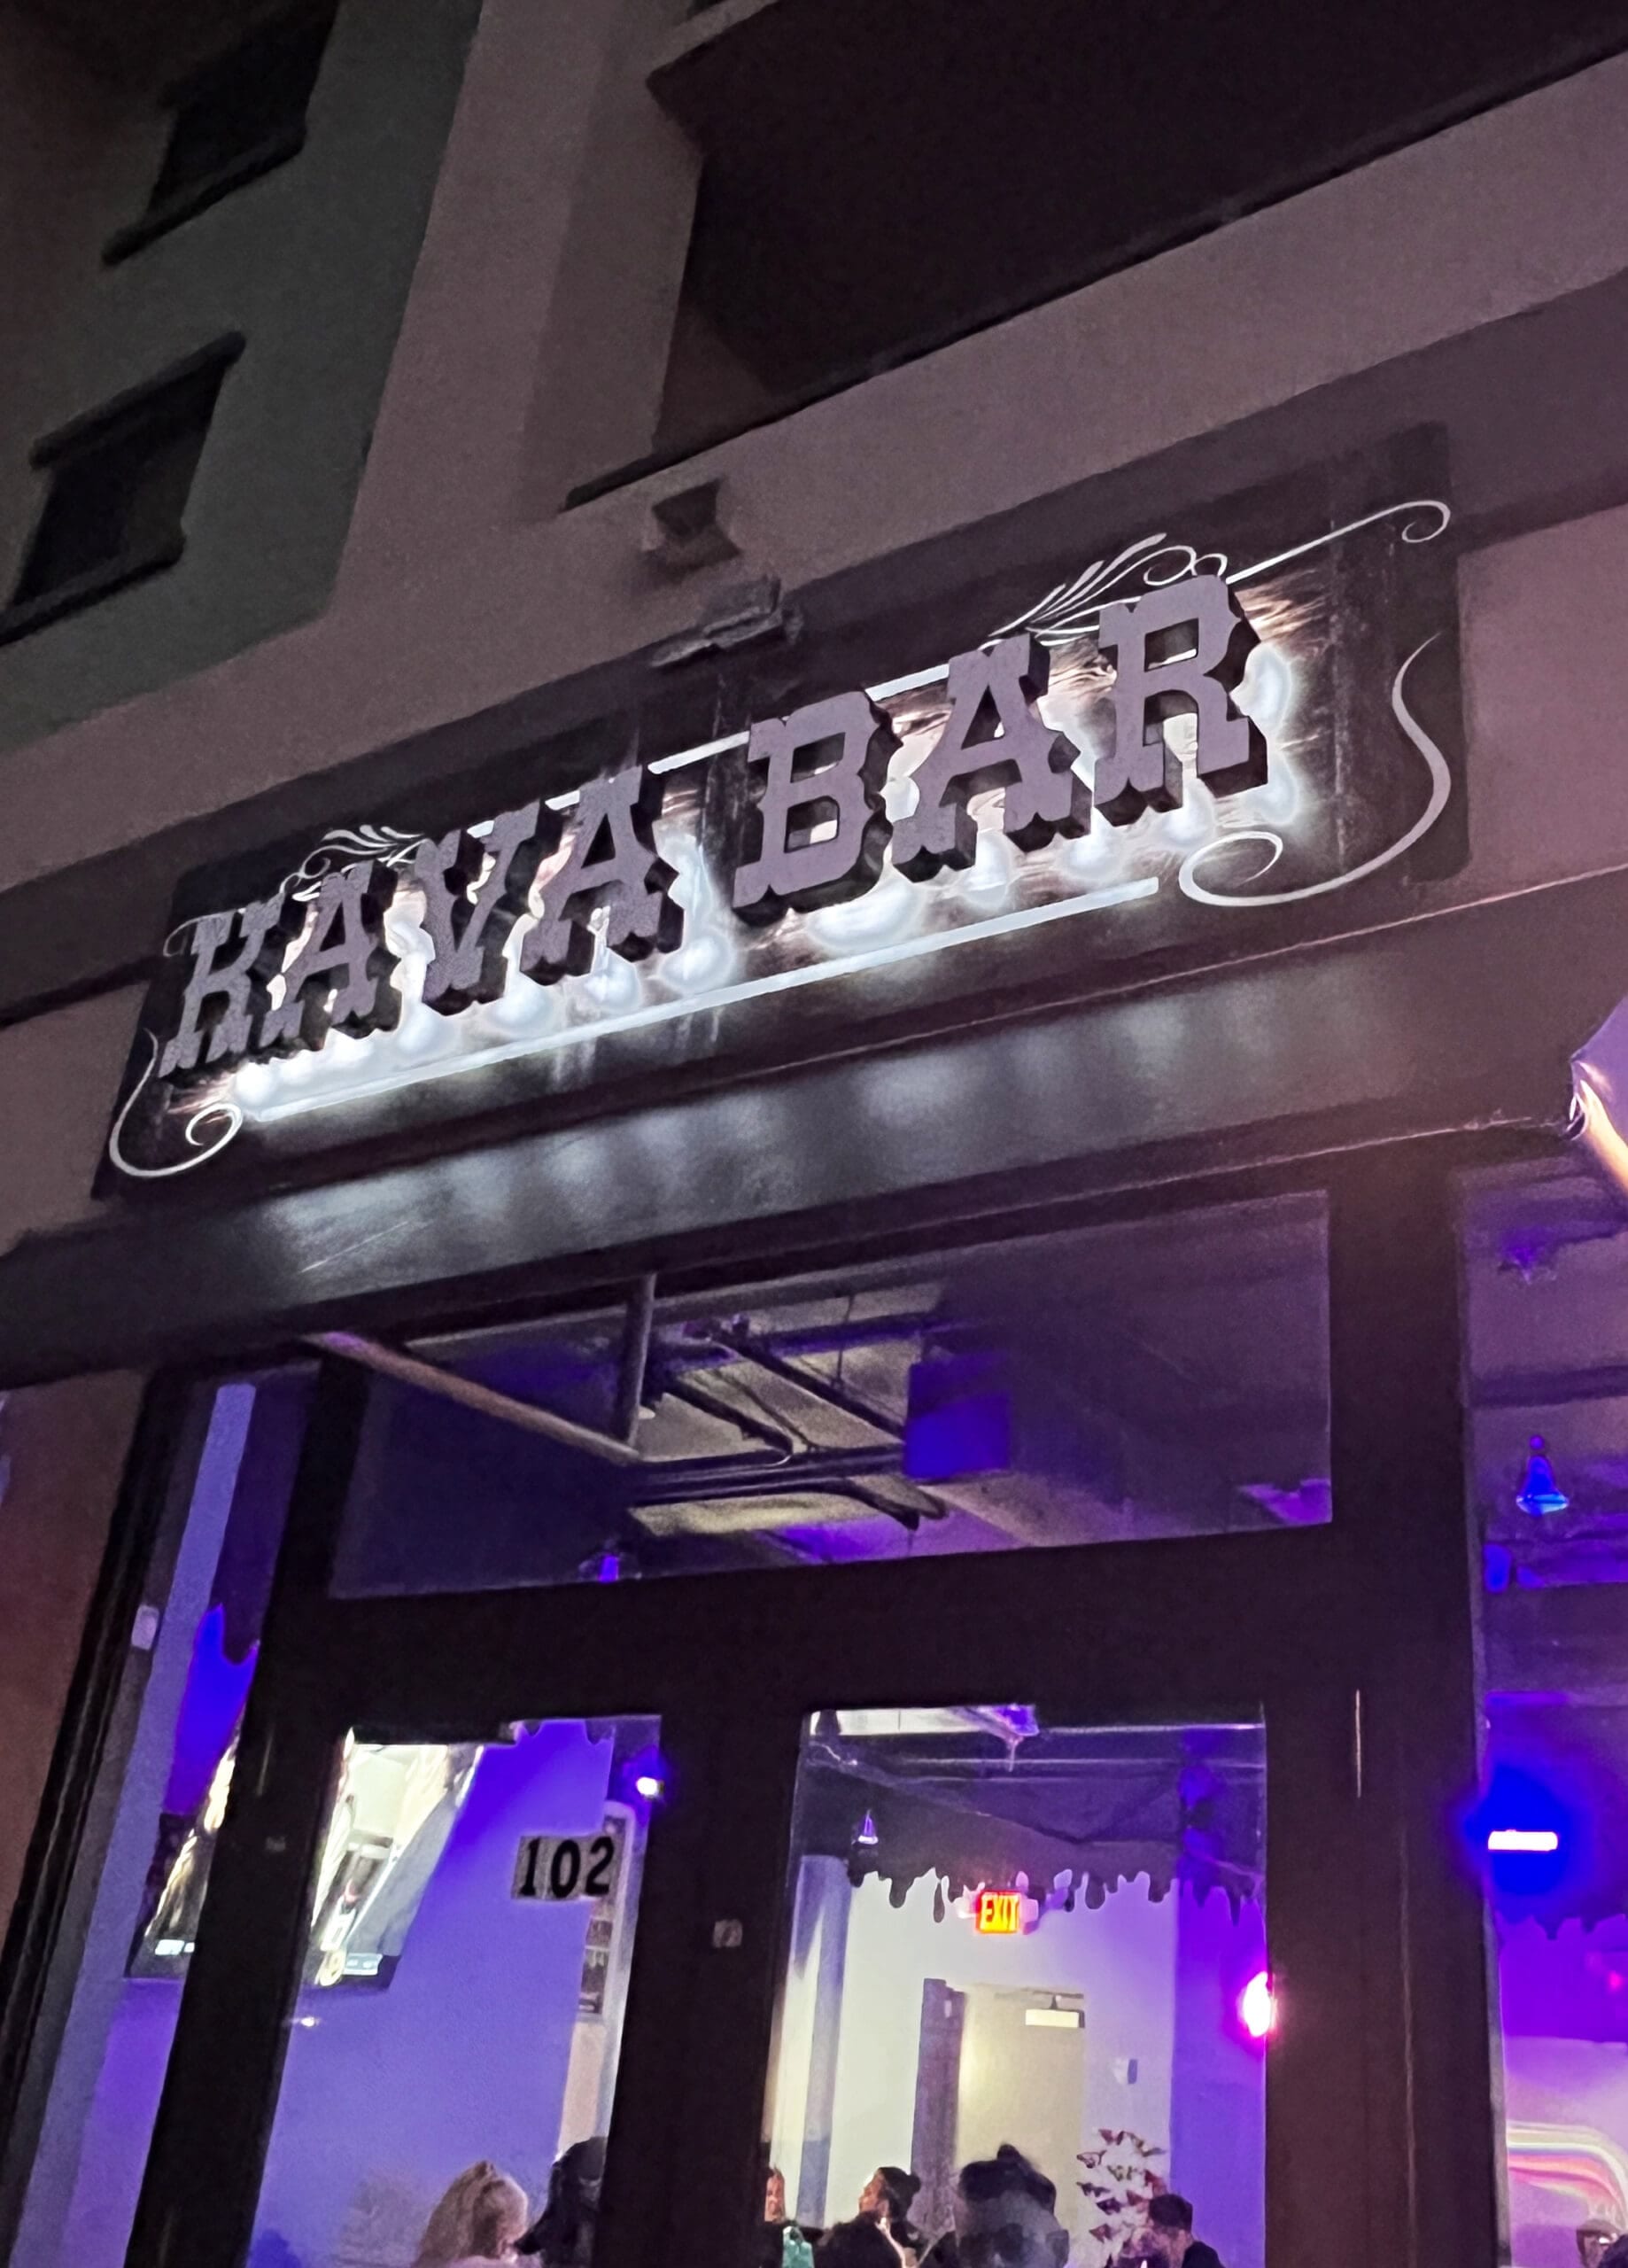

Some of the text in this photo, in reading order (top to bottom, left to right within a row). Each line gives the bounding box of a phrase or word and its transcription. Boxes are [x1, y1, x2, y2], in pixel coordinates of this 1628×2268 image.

[158, 574, 1254, 1078] KAVA BAR
[518, 1836, 615, 1899] 102
[980, 1893, 1019, 1931] EXIT
